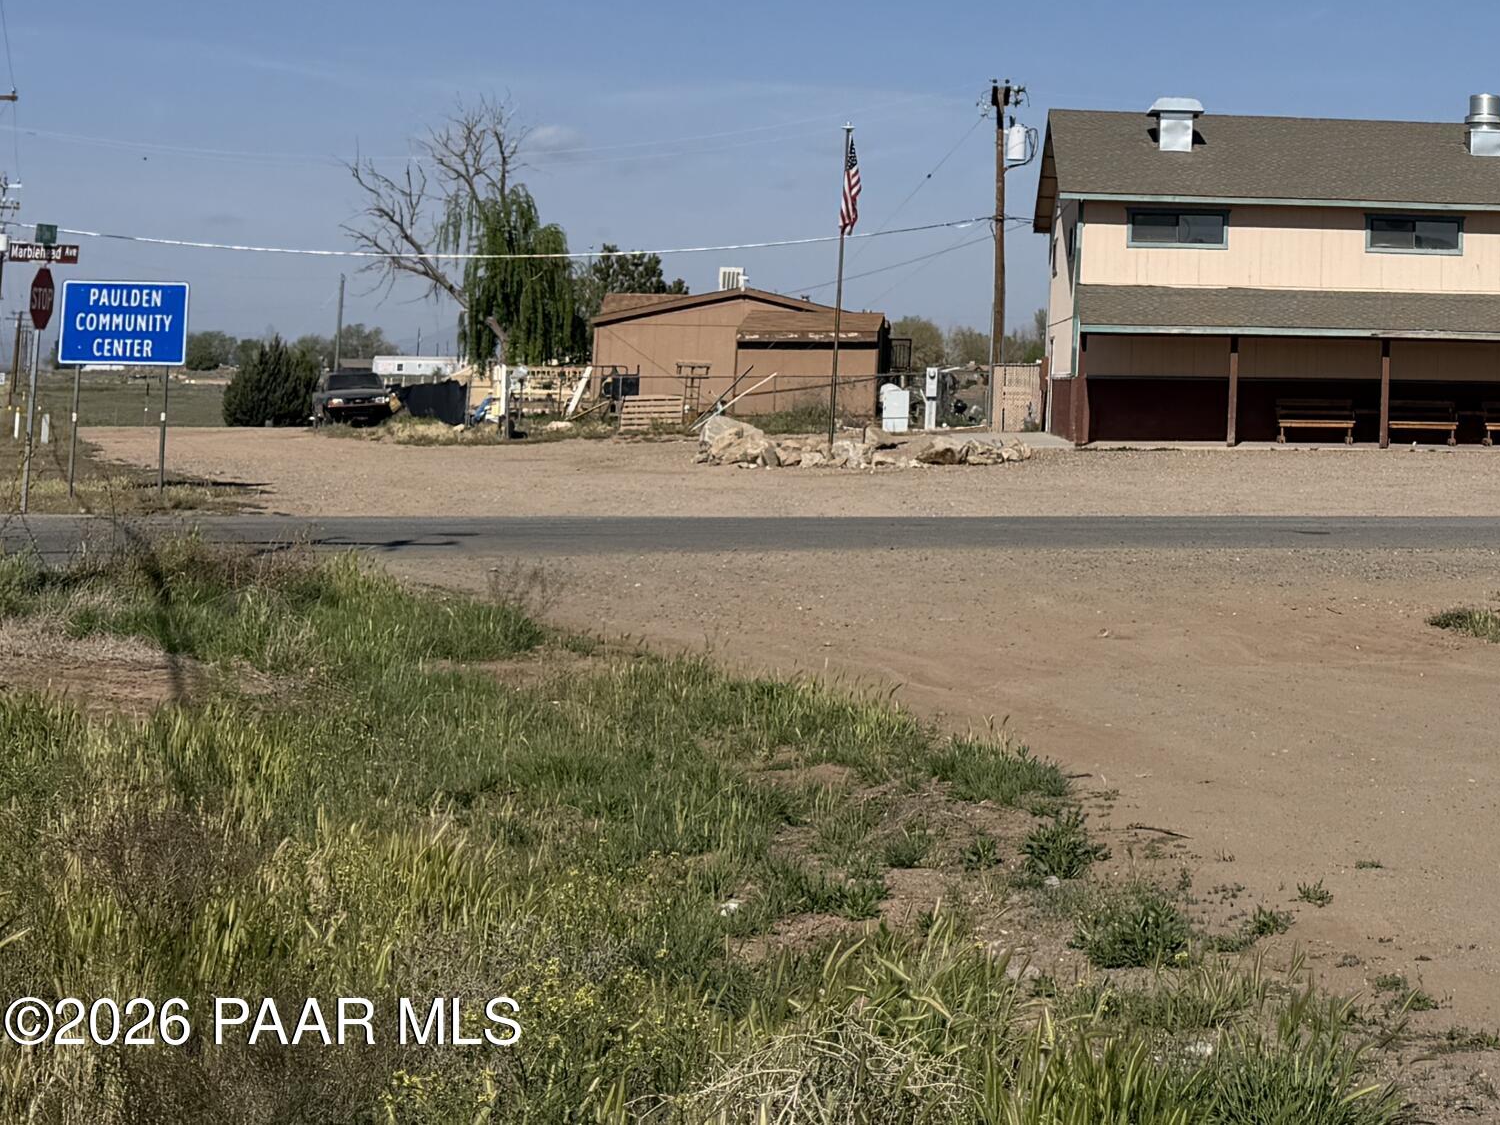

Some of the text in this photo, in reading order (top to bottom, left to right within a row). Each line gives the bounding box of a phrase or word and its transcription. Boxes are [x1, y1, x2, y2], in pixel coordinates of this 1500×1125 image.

[65, 246, 77, 257] Ave
[32, 287, 53, 310] STOP
[89, 288, 162, 307] PAULDEN
[75, 312, 173, 332] COMMUNITY
[92, 338, 153, 358] CENTER
